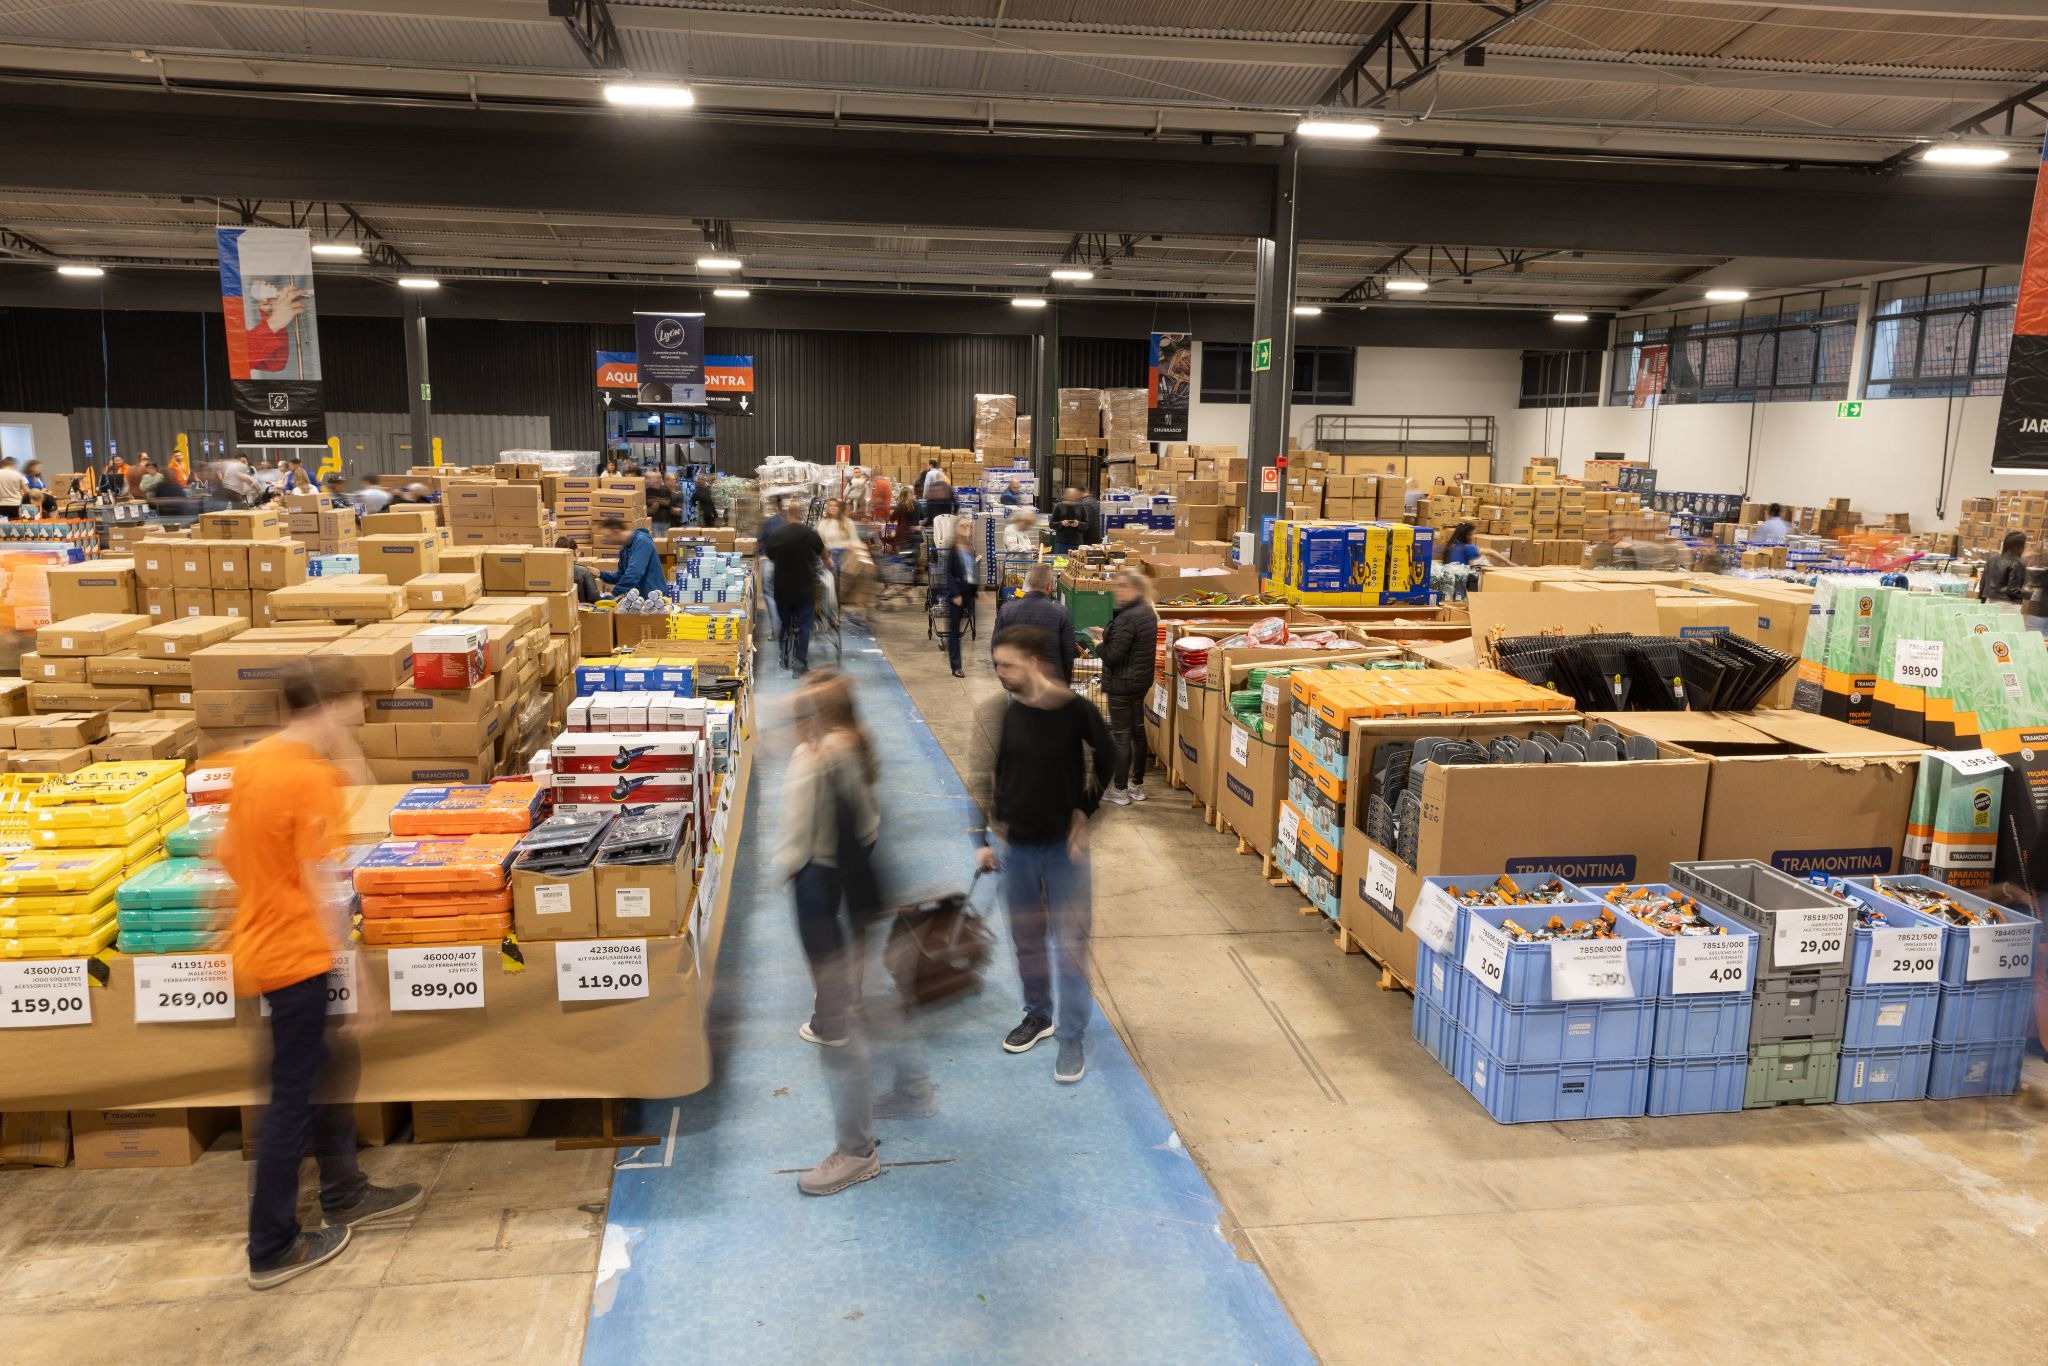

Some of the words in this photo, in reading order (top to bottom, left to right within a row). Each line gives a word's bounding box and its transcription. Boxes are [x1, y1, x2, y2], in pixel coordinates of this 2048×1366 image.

[605, 371, 637, 383] AQUI
[704, 375, 746, 386] ONTRA
[253, 419, 308, 428] MATERIAIS
[254, 429, 309, 438] ELÉTRICOS
[1902, 665, 1938, 679] 989,00
[416, 771, 465, 780] TRAMONTINA
[1781, 854, 1882, 872] TRAMONTINA
[1952, 853, 1990, 861] TRAMONTINA
[1515, 862, 1626, 879] TRAMONTINA
[1948, 871, 1991, 879] APARADOR
[1960, 879, 1990, 887] GRAMA
[1375, 881, 1393, 900] 10,00
[1898, 933, 1938, 942] 78521/500
[590, 945, 641, 954] 42380/046
[1703, 941, 1744, 950] 78515/000
[1800, 939, 1840, 955] 29,00
[423, 952, 477, 961] 46000/407
[1999, 954, 2029, 970] 5,00
[23, 966, 81, 975] 43600/017
[171, 960, 227, 969] 41191/165
[1481, 957, 1500, 980] 3,00
[1893, 959, 1934, 974] 29,00
[578, 974, 643, 990] 119,00
[1710, 967, 1742, 983] 4,00
[411, 981, 478, 999] 899,00
[11, 997, 83, 1015] 159,00
[159, 991, 229, 1009] 269,00
